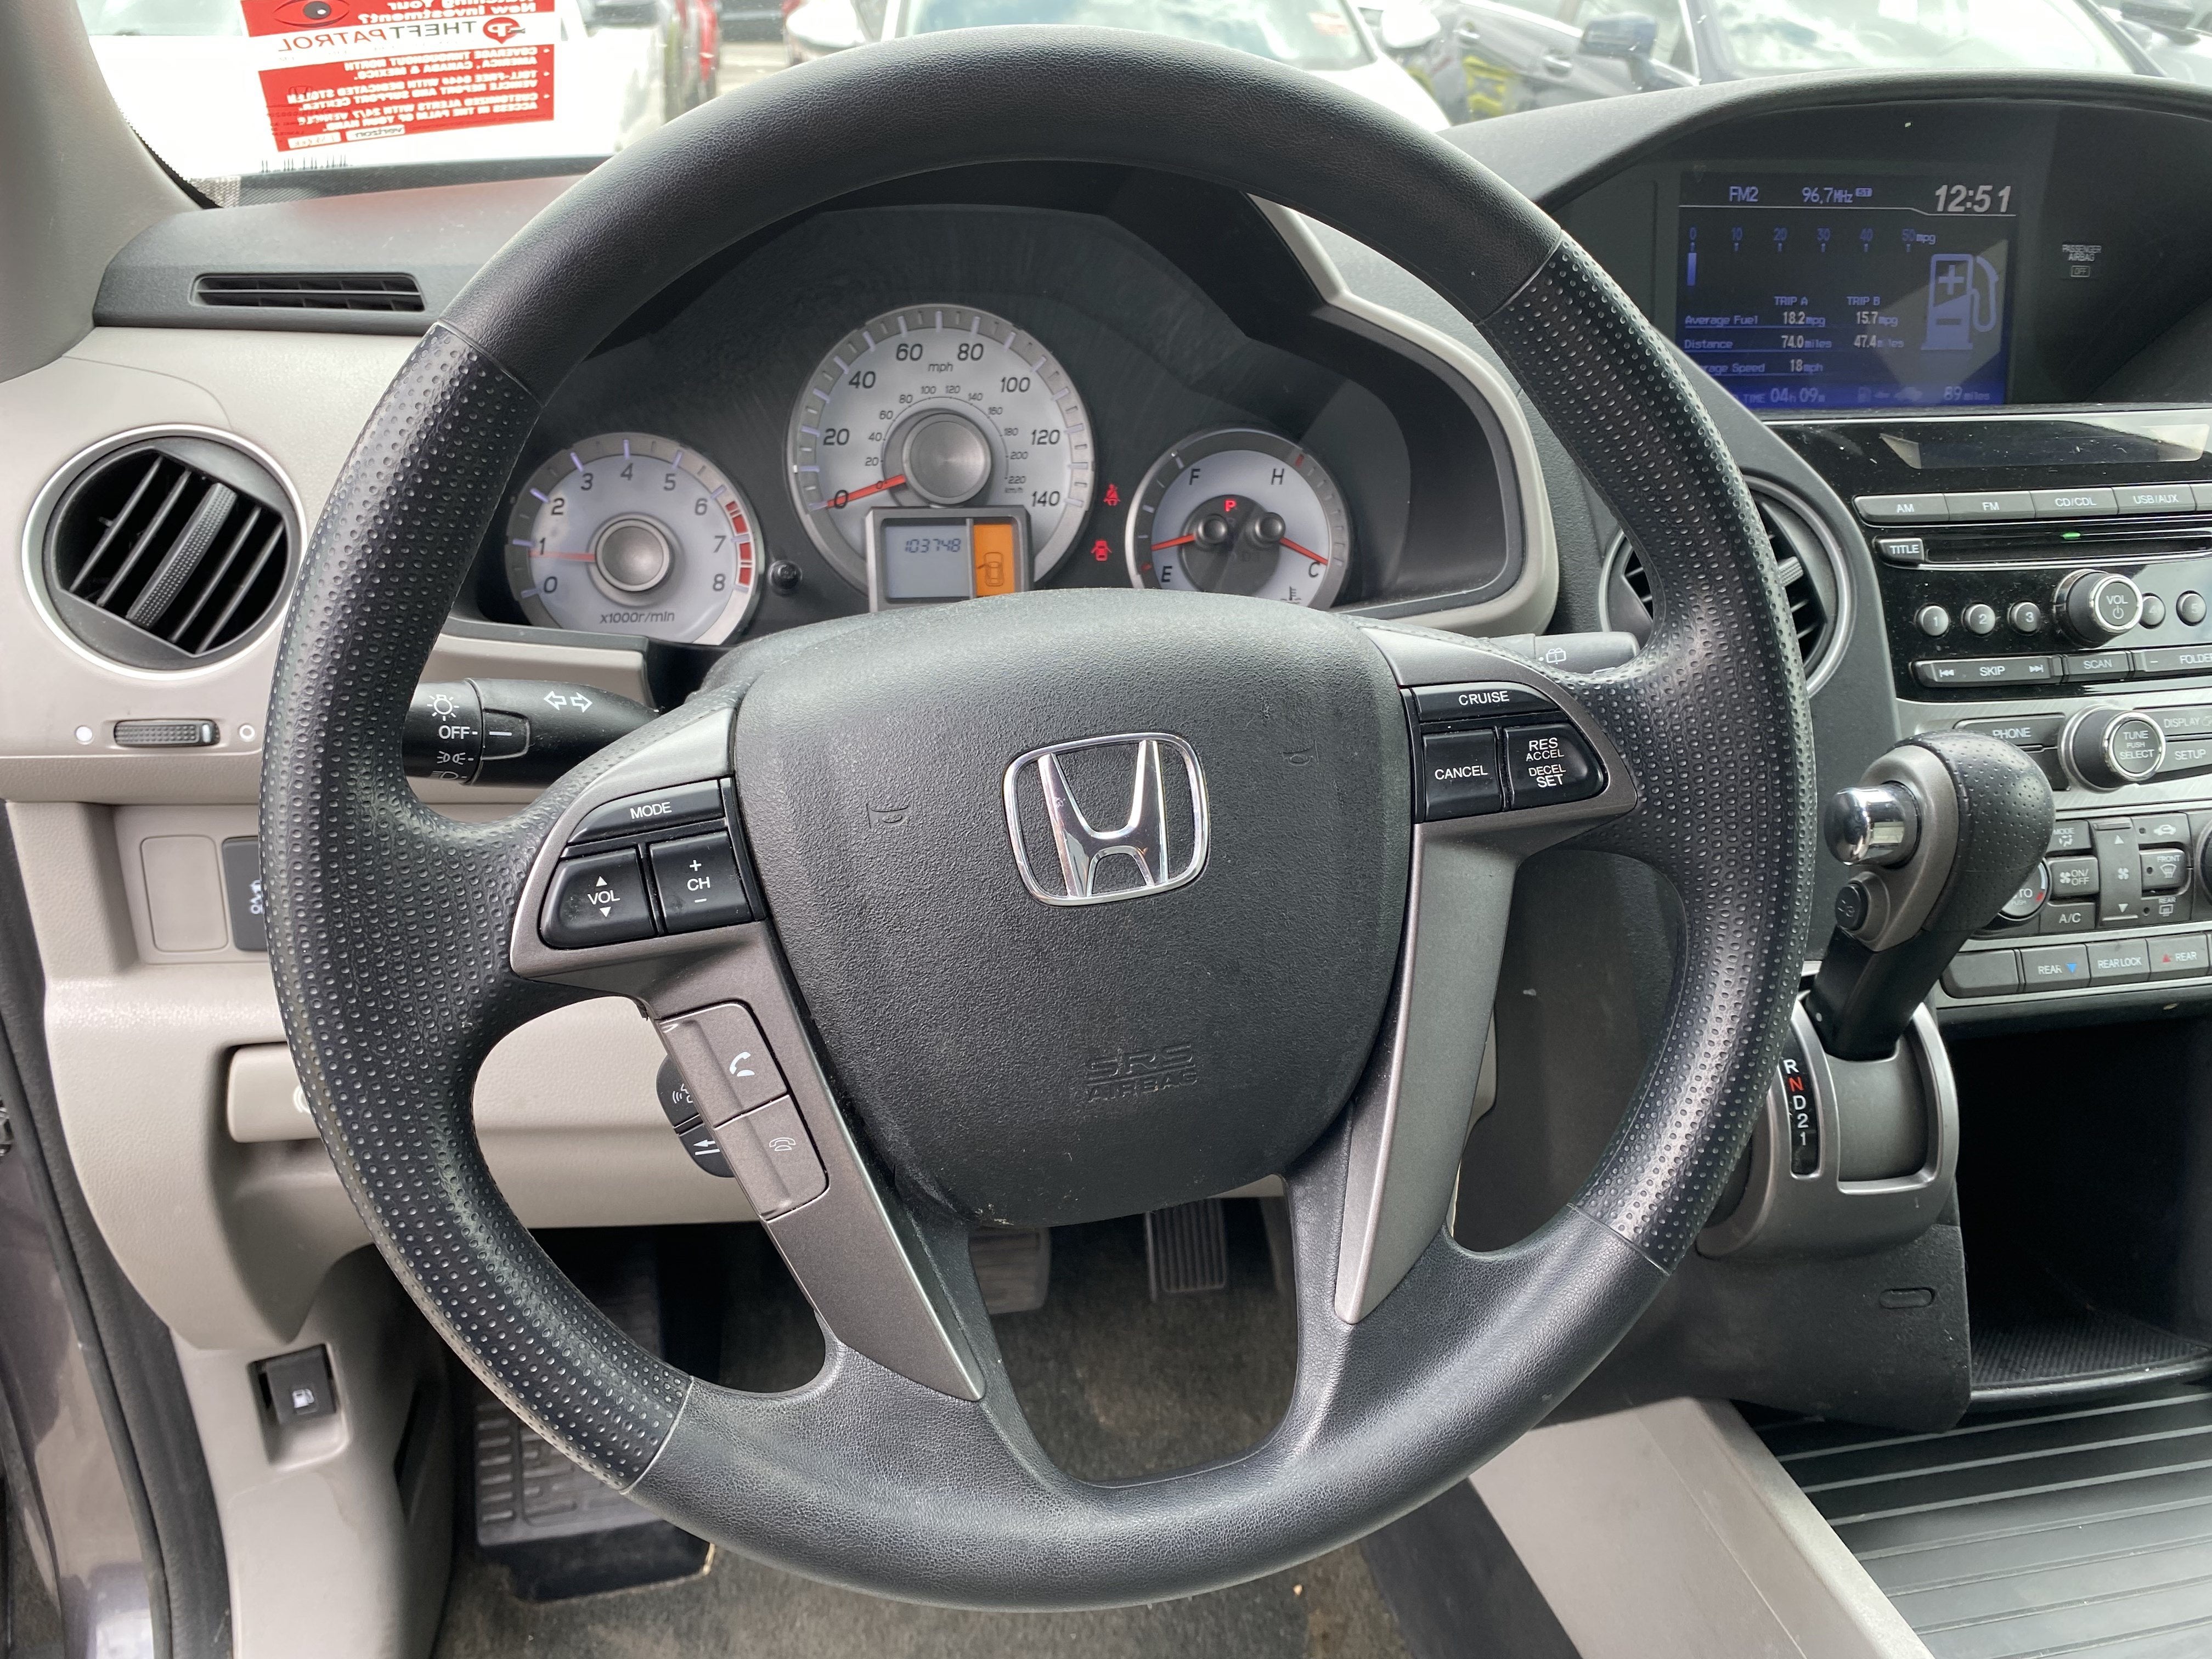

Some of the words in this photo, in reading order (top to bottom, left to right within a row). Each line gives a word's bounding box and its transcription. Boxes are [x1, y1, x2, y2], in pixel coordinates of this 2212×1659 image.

[1729, 186, 1759, 202] FM2
[1935, 184, 2012, 212] 12:51
[1689, 227, 1697, 240] 0
[1731, 227, 1743, 240] 10
[1774, 227, 1787, 241] 20
[1817, 228, 1831, 241] 30
[1860, 228, 1874, 241] 40
[2068, 253, 2095, 262] AIRBAG
[1774, 296, 1797, 306] TRIP
[1801, 296, 1808, 306] A
[1847, 296, 1870, 306] TRIP
[1873, 296, 1881, 306] B
[1685, 315, 1730, 327] Average
[1734, 315, 1758, 324] Fuel
[1684, 340, 1733, 349] Distance
[896, 343, 923, 361] 60
[957, 343, 984, 361] 80
[928, 362, 953, 373] mph
[1732, 363, 1765, 373] Speed
[849, 370, 876, 389] 40
[1000, 376, 1030, 393] 100
[921, 386, 936, 394] 100
[945, 385, 961, 394] 120
[899, 394, 913, 403] 80
[968, 393, 983, 401] 140
[1743, 394, 1765, 403] TIME
[879, 410, 893, 420] 60
[823, 428, 849, 445] 20
[868, 432, 882, 441] 40
[1004, 428, 1018, 436] 180
[1031, 430, 1060, 445] 120
[865, 457, 879, 466] 20
[620, 463, 633, 481] 4
[1189, 469, 1200, 485] F
[1271, 469, 1284, 485] H
[580, 473, 594, 490] 3
[664, 473, 676, 490] 5
[876, 481, 883, 489] 0
[834, 489, 849, 509] 0
[1031, 491, 1060, 506] 140
[2133, 494, 2179, 504] USB/AUX
[551, 498, 565, 515] 2
[695, 498, 708, 516] 6
[1224, 500, 1236, 512] P
[1897, 504, 1915, 513] AM
[1983, 501, 2000, 511] FM
[539, 537, 546, 555] 1
[713, 535, 726, 553] 7
[905, 538, 961, 553] 103748
[1890, 544, 1919, 555] TITLE
[1161, 566, 1172, 583] E
[1308, 562, 1319, 578] C
[544, 577, 557, 593] 0
[713, 573, 725, 591] 8
[2106, 595, 2129, 605] VOL
[2191, 603, 2199, 613] 5
[599, 611, 675, 624] x1000r/min
[1933, 617, 1938, 627] 1
[1979, 614, 1987, 624] 2
[2025, 612, 2034, 623] 3
[2084, 659, 2112, 669] SCAN
[2180, 653, 2212, 664] FOLDE
[1980, 666, 2005, 676] SKIP
[1458, 691, 1510, 706] CRUISE
[2163, 717, 2200, 729] DISPLAY
[439, 725, 470, 740] OFF
[1993, 727, 2031, 739] PHONE
[2123, 730, 2149, 740] TUNE
[1529, 737, 1558, 751] RES
[1526, 748, 1565, 761] ACCEL
[2120, 749, 2154, 759] SELECT
[2175, 750, 2206, 760] SETUP
[1434, 765, 1488, 780] CANCEL
[1529, 764, 1566, 776] DECEL
[1537, 775, 1564, 788] SET
[630, 801, 672, 820] MODE
[2071, 869, 2089, 878] ON/
[686, 876, 710, 891] CH
[2072, 877, 2089, 885] OFF
[588, 889, 620, 904] VOL
[2059, 913, 2081, 923] A/C
[2175, 951, 2197, 962] REAR
[2097, 959, 2119, 969] REAR
[2120, 957, 2142, 967] LOCK
[2038, 965, 2063, 975] REAR
[1784, 1059, 1799, 1075] R
[1788, 1076, 1804, 1092] N
[1793, 1094, 1806, 1110] D
[1797, 1113, 1809, 1128] 2
[1800, 1132, 1806, 1146] 1
